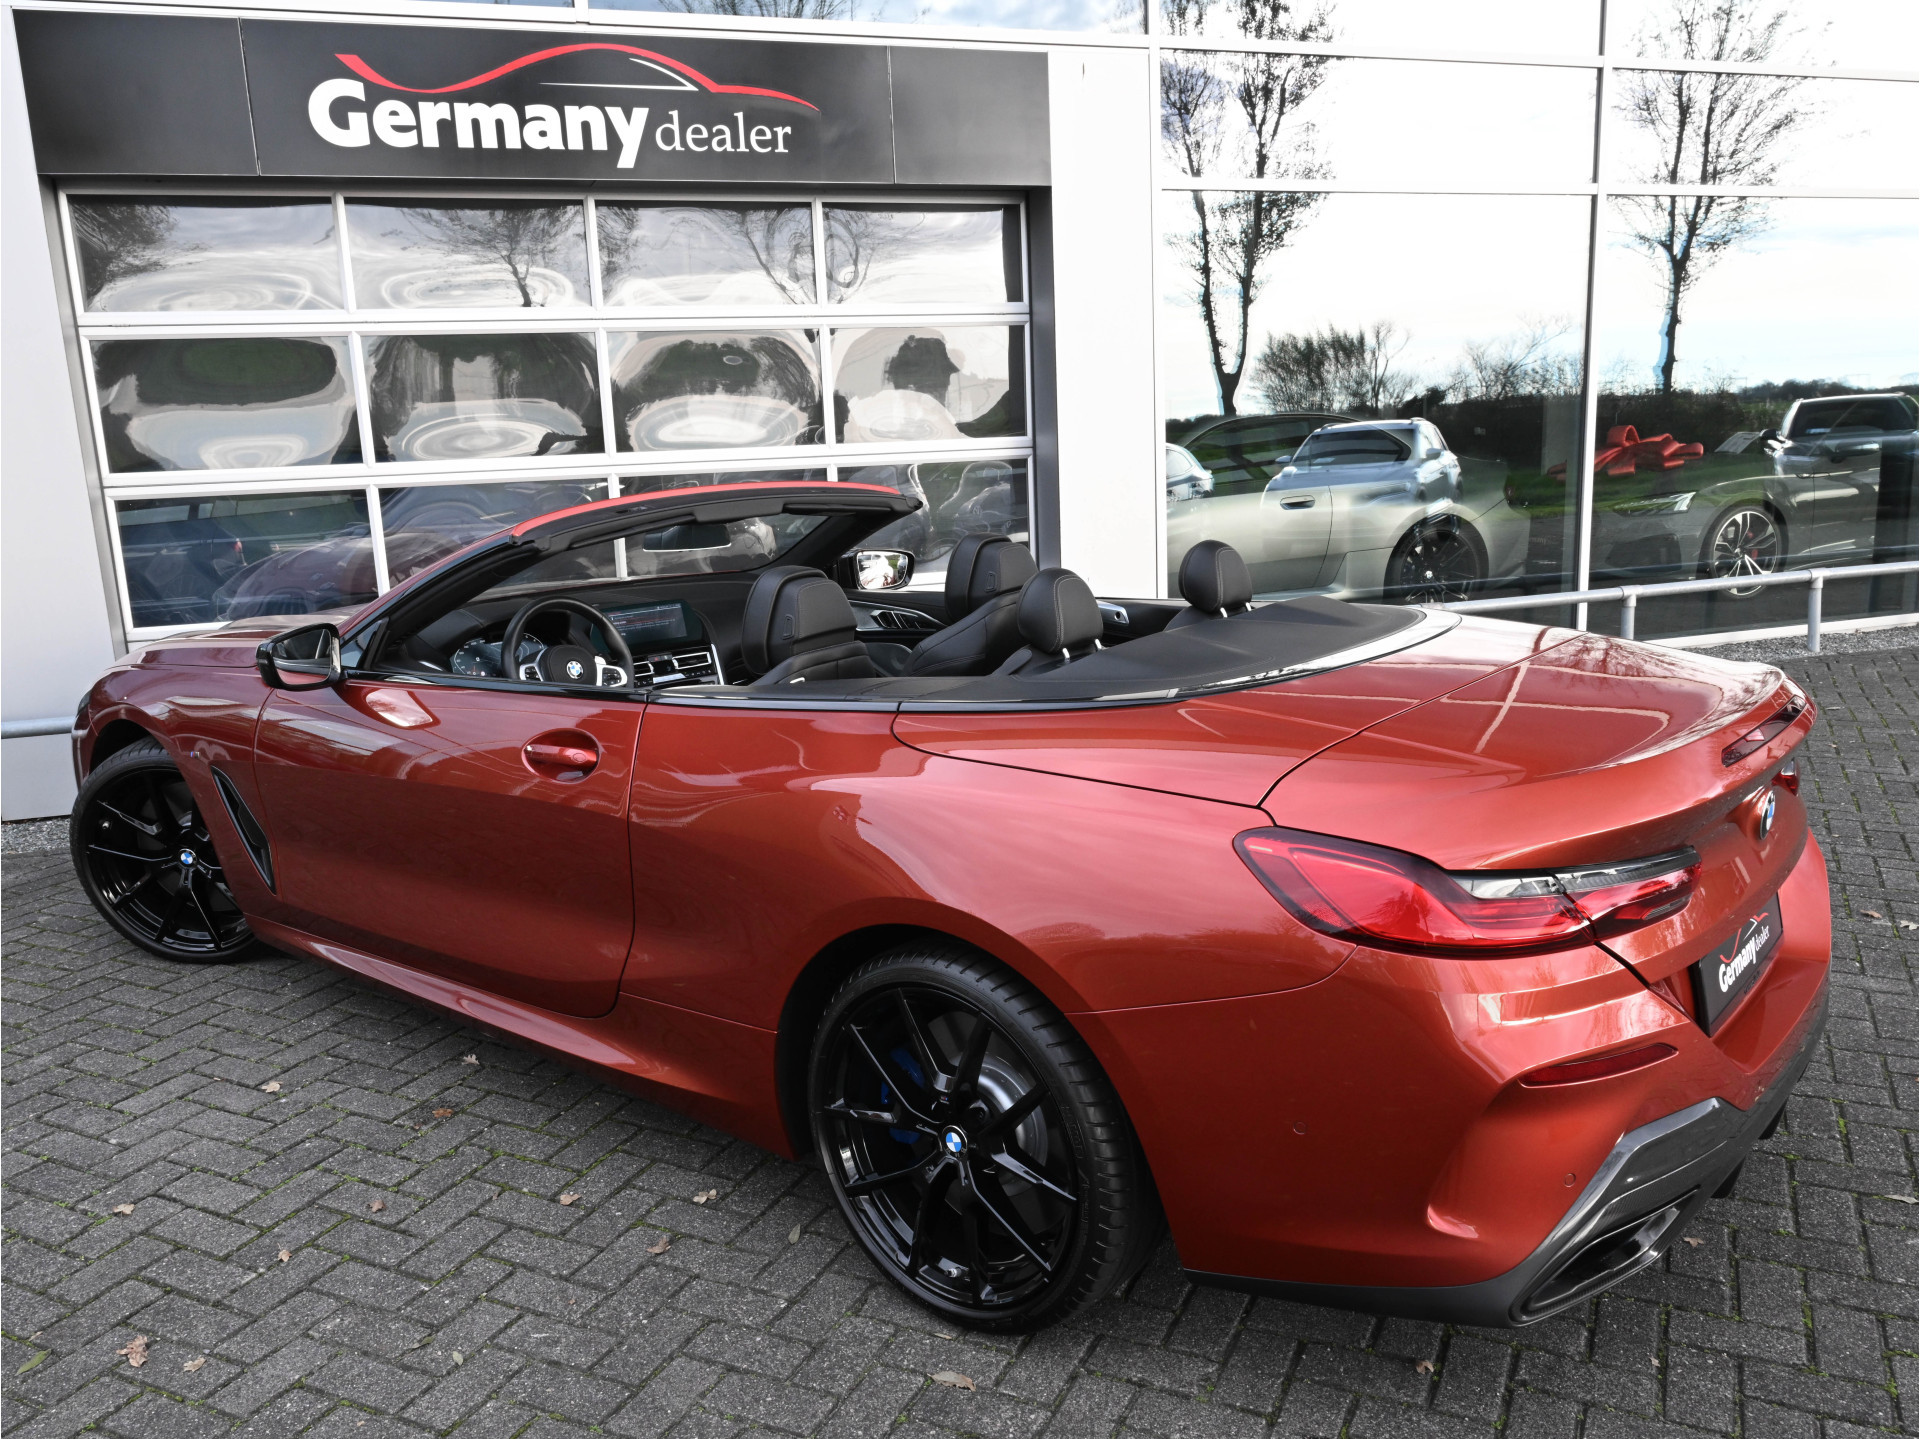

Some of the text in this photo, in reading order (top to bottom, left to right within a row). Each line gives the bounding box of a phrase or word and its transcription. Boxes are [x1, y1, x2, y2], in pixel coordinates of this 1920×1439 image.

[308, 78, 792, 168] Germany dealer
[1718, 936, 1756, 993] Germany
[1755, 925, 1770, 951] dealer
